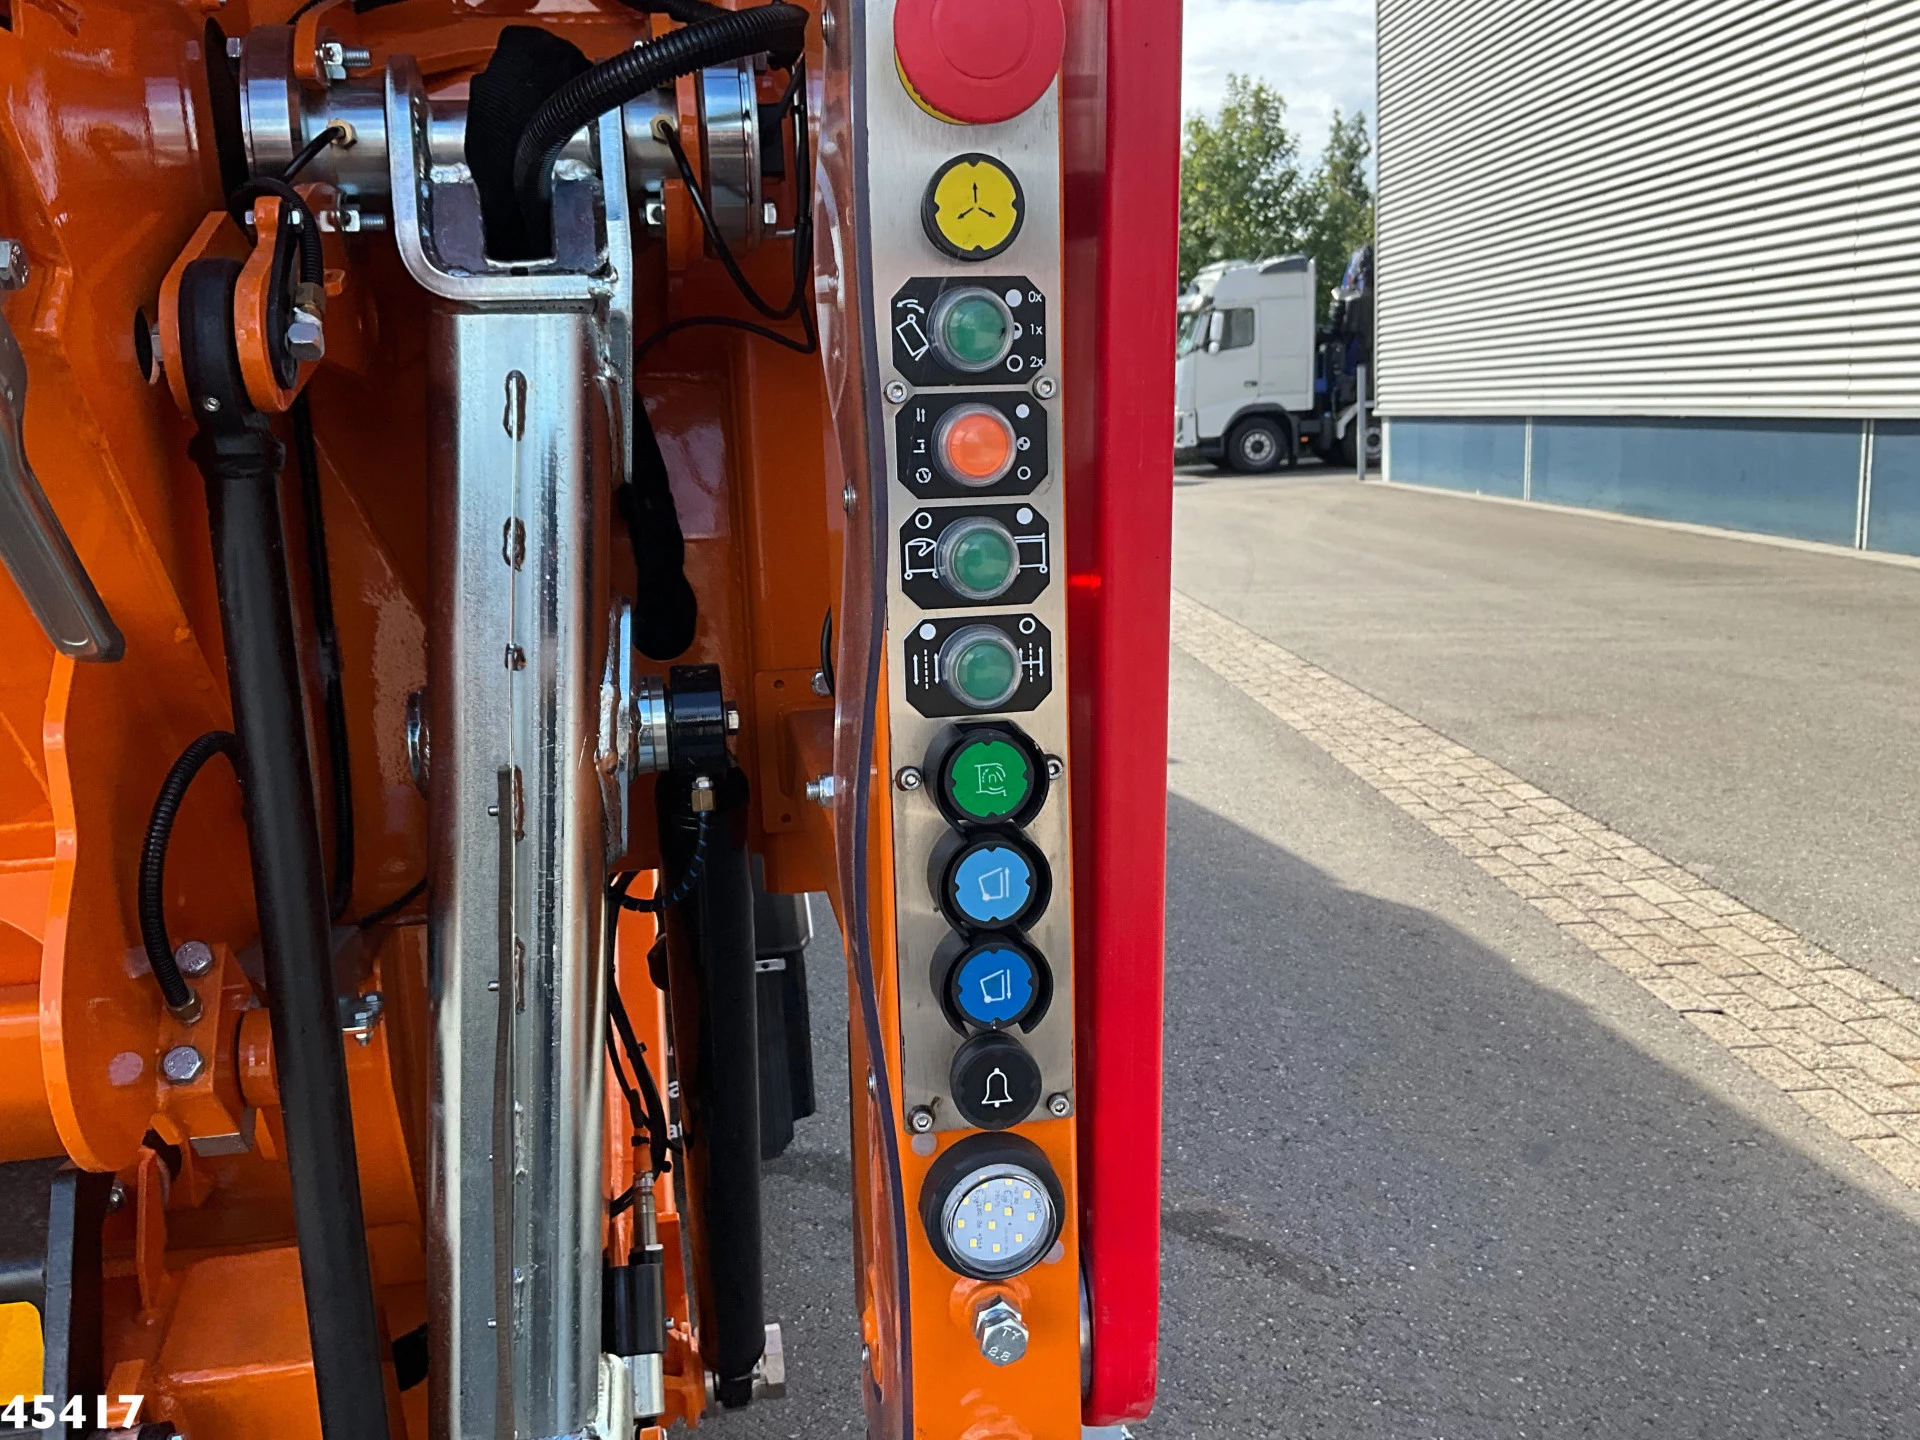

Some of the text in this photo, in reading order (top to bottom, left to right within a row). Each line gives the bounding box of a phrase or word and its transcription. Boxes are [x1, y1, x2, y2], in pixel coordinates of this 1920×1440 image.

[1028, 290, 1043, 303] 0x
[1030, 323, 1043, 335] 1x
[1029, 355, 1044, 368] 2x
[988, 1346, 1011, 1361] 8.8
